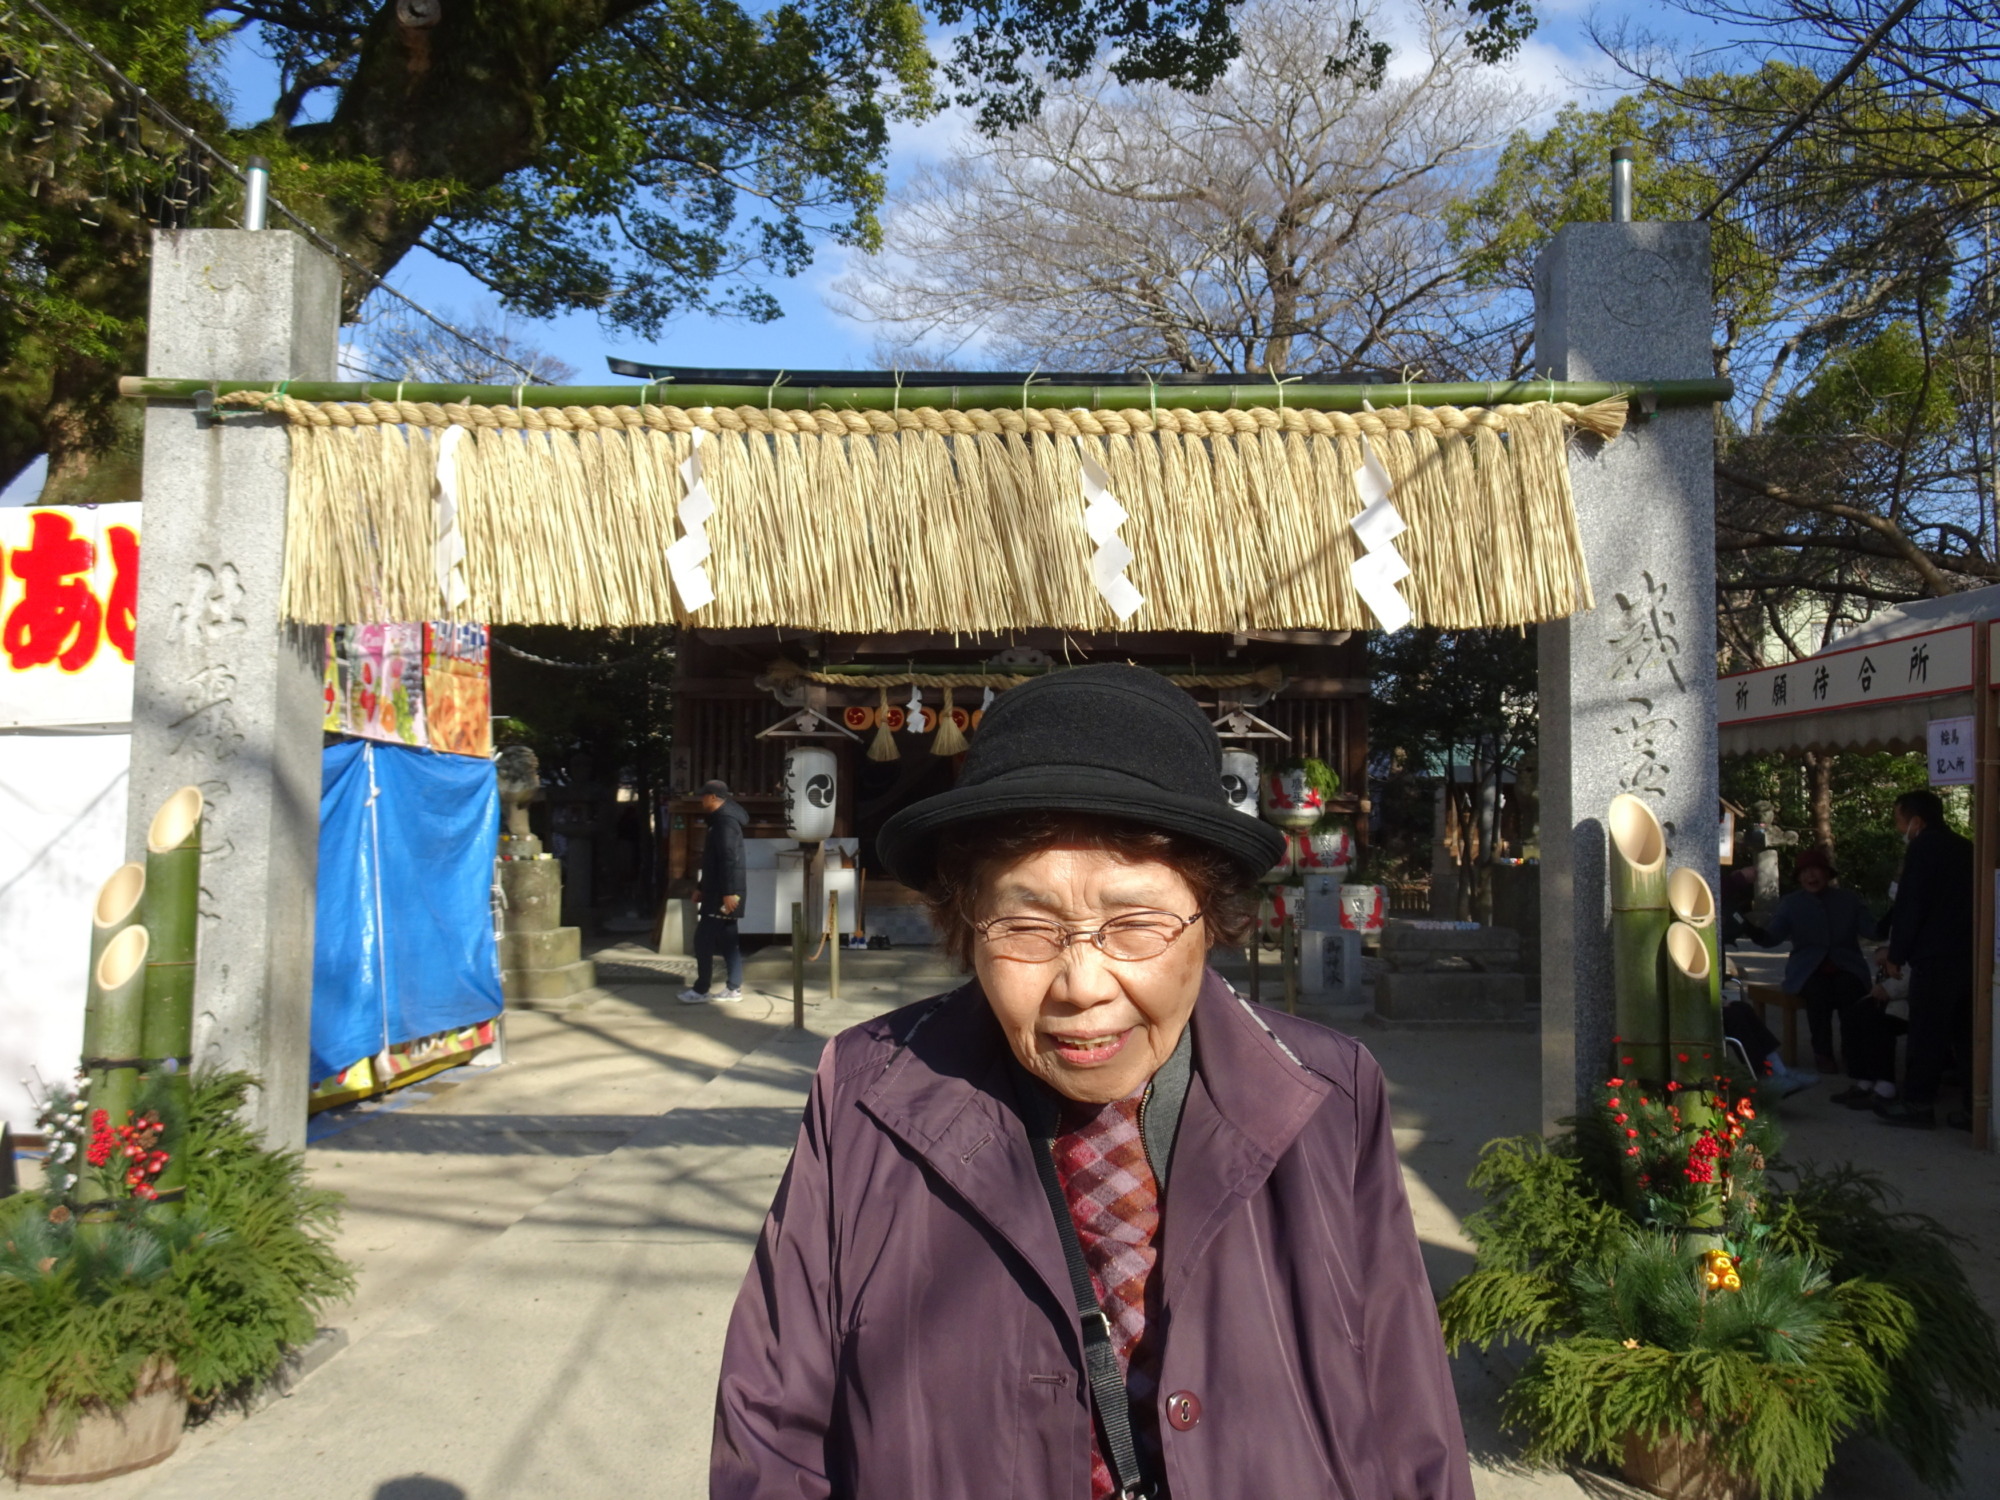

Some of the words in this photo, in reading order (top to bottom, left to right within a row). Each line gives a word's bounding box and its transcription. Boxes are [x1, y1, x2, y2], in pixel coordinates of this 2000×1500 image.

[1735, 643, 1930, 712] 祈願待合所
[1940, 729, 1960, 746] 絵馬
[1936, 756, 1965, 775] 記入所
